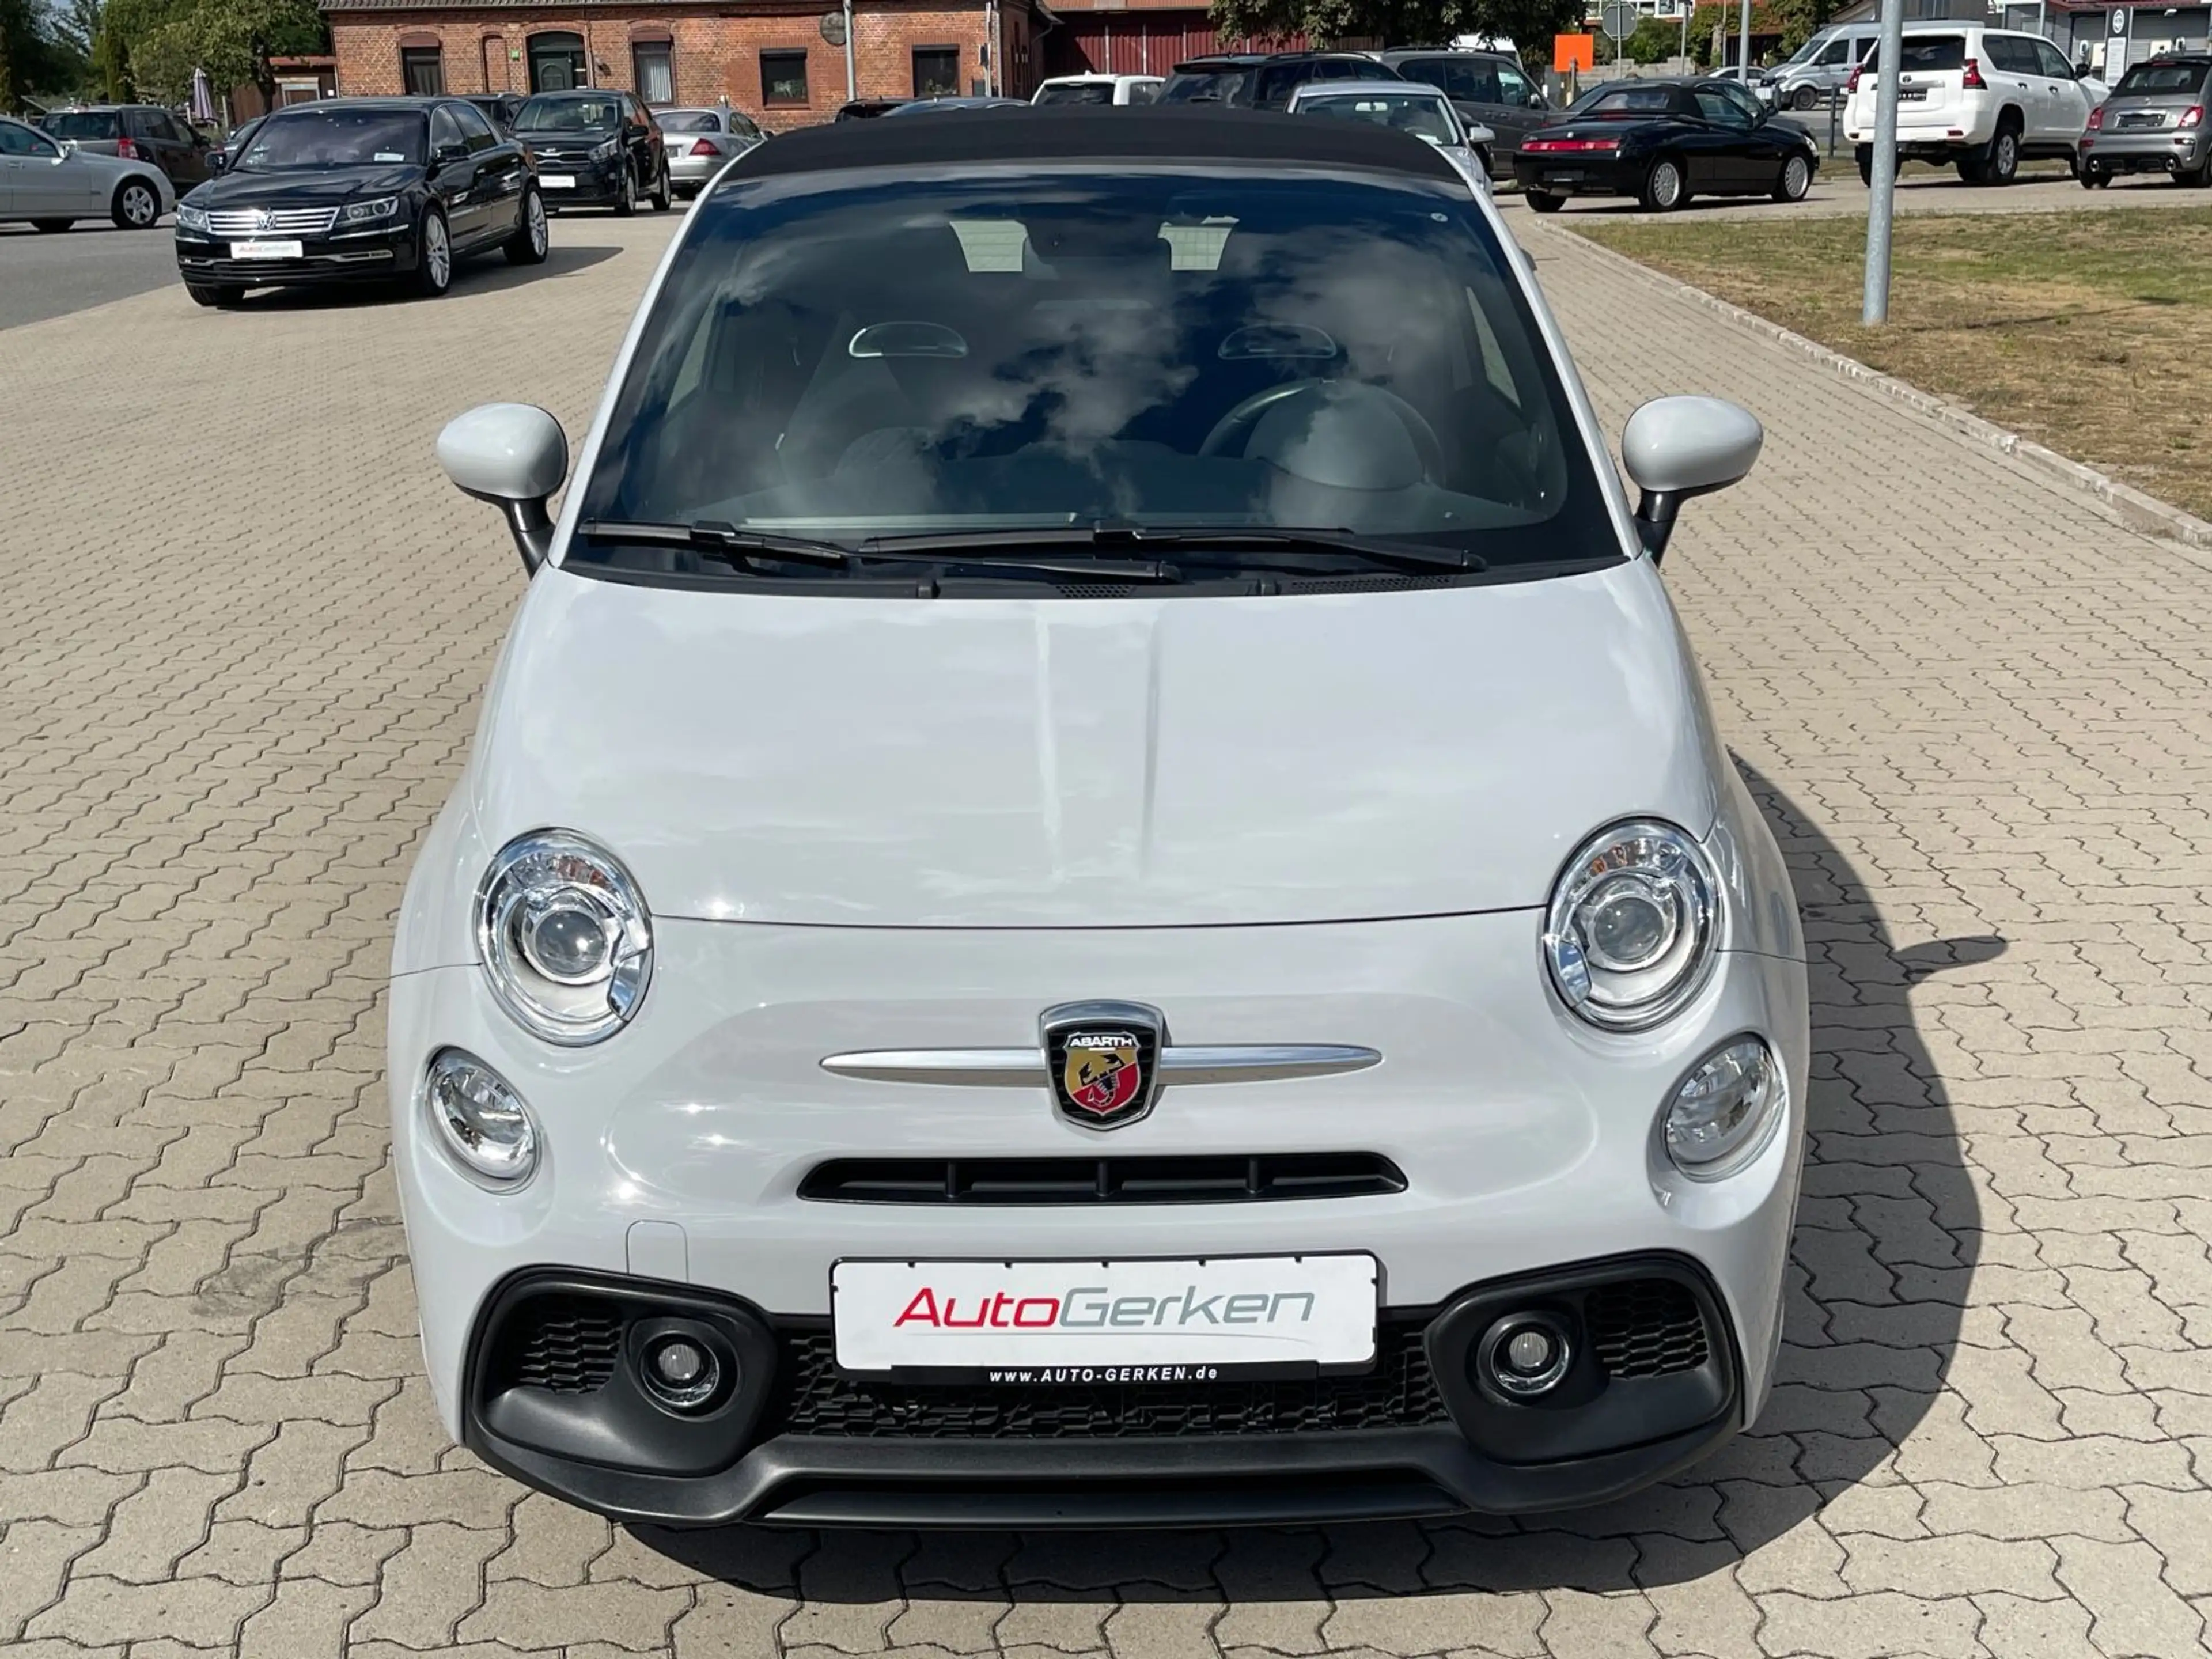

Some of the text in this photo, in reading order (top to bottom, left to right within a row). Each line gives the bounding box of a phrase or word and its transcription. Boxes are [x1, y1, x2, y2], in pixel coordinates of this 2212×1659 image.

[1070, 1036, 1132, 1047] ABARTH
[893, 1286, 1315, 1328] AutoGerken
[990, 1366, 1218, 1382] www.AUTO-GERKEN.de
